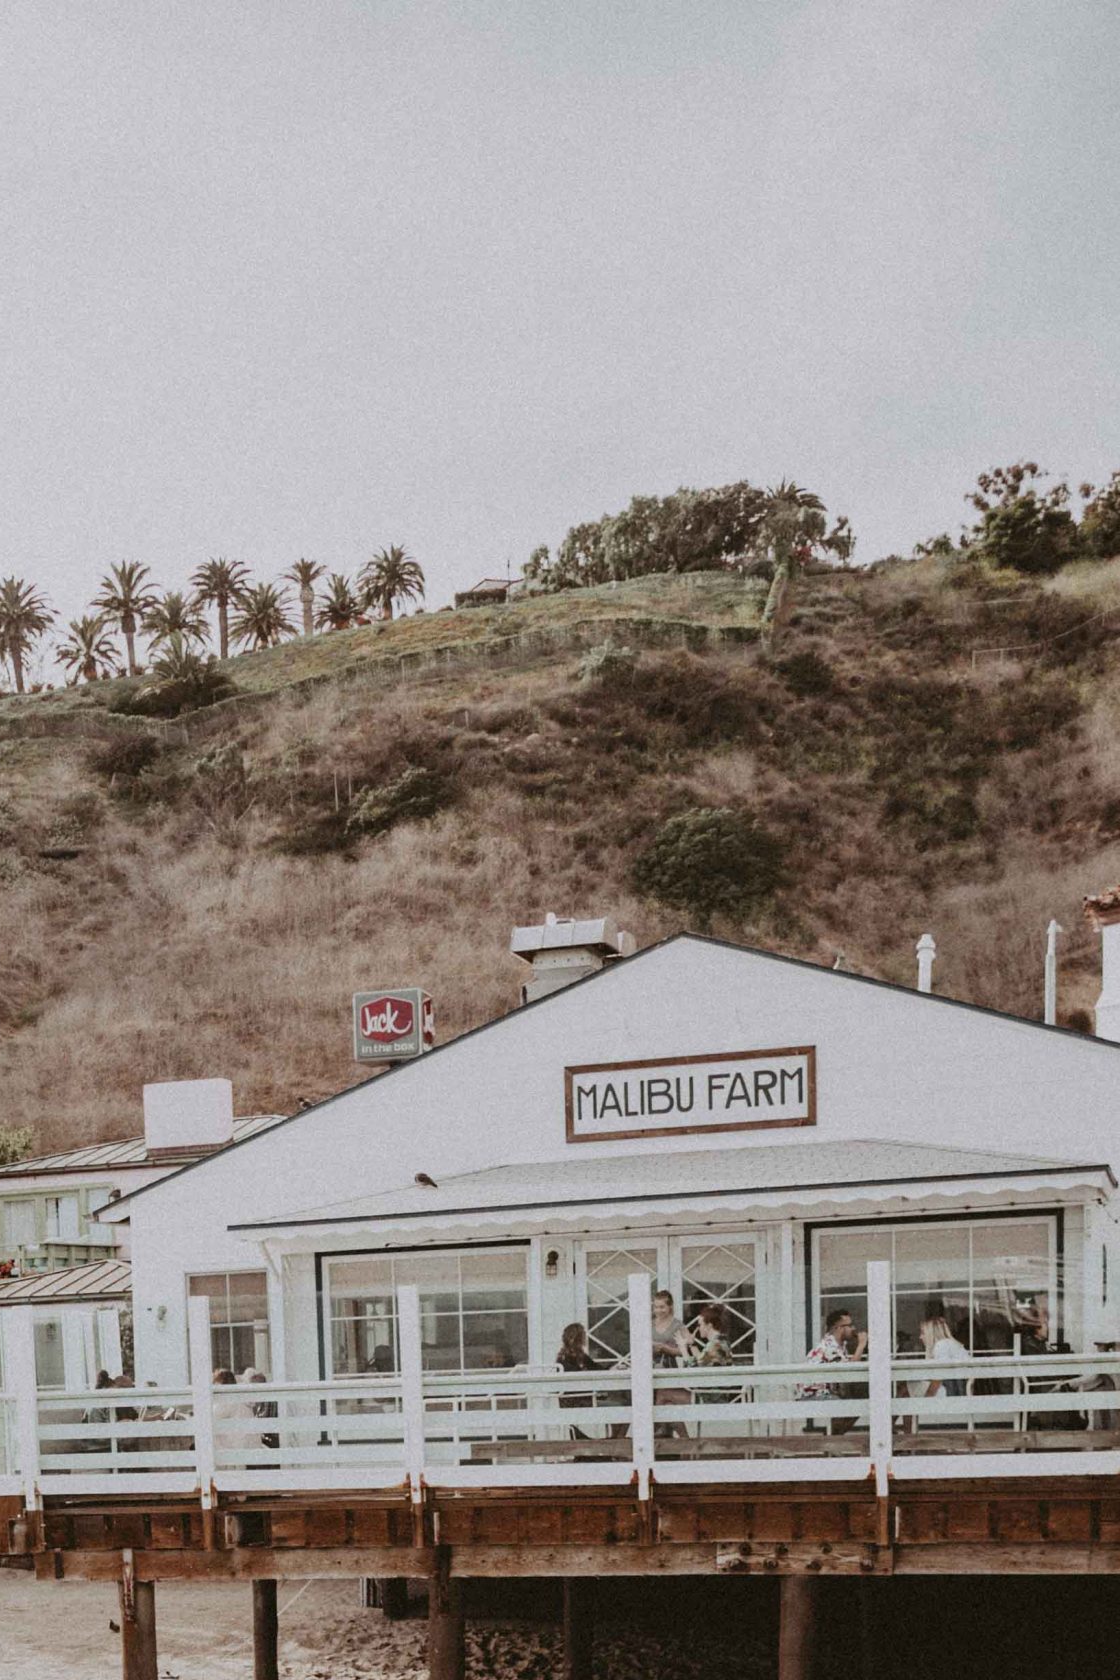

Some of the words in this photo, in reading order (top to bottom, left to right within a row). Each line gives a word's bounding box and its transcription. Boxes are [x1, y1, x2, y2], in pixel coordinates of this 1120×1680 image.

[361, 1001, 412, 1036] Jack
[361, 1045, 373, 1054] in
[373, 1043, 393, 1053] the
[393, 1042, 415, 1052] box
[577, 1076, 694, 1120] MALIBU
[708, 1067, 803, 1110] FARM
